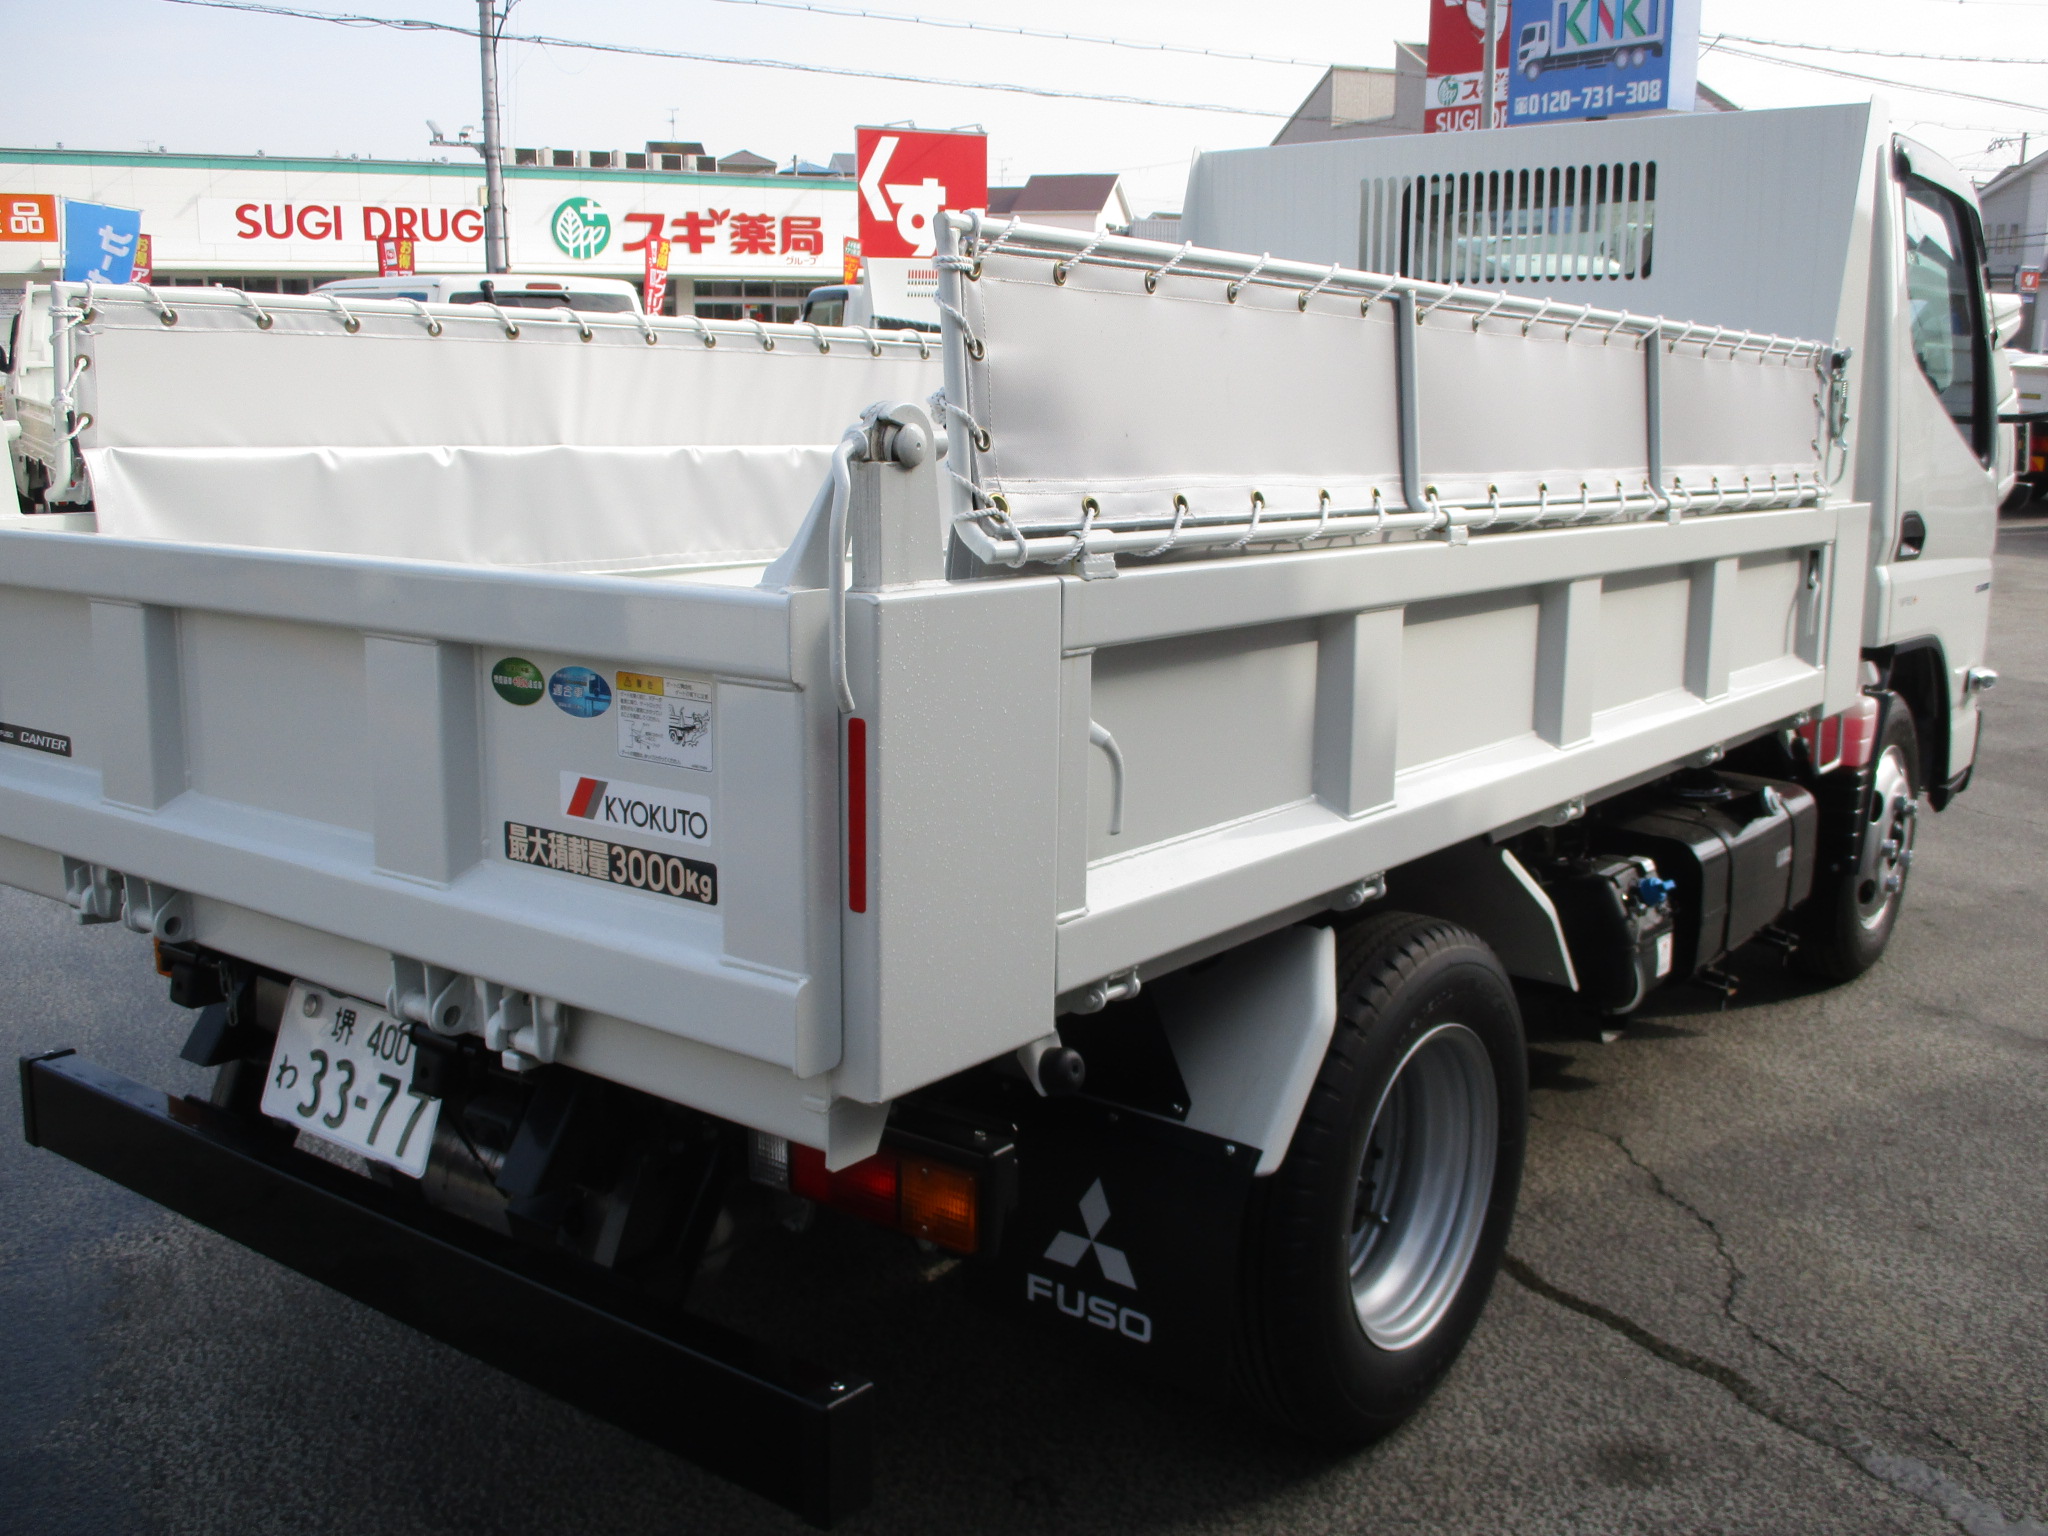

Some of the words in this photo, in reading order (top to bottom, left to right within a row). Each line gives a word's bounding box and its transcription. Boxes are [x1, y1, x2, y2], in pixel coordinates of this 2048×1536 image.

[1435, 107, 1479, 132] SUGI
[1529, 79, 1661, 115] 0120-731-308
[0, 202, 45, 234] 品
[859, 136, 985, 256] くす
[235, 203, 343, 241] SUGI
[363, 205, 484, 243] DRUG
[623, 207, 824, 256] スギ薬局
[20, 731, 68, 752] CANTER
[605, 795, 708, 840] KYOKUTO
[330, 1006, 358, 1046] 堺
[366, 1020, 412, 1067] 400
[275, 1053, 298, 1089] わ
[296, 1048, 431, 1158] 33-77
[1027, 1272, 1152, 1344] FUSO
